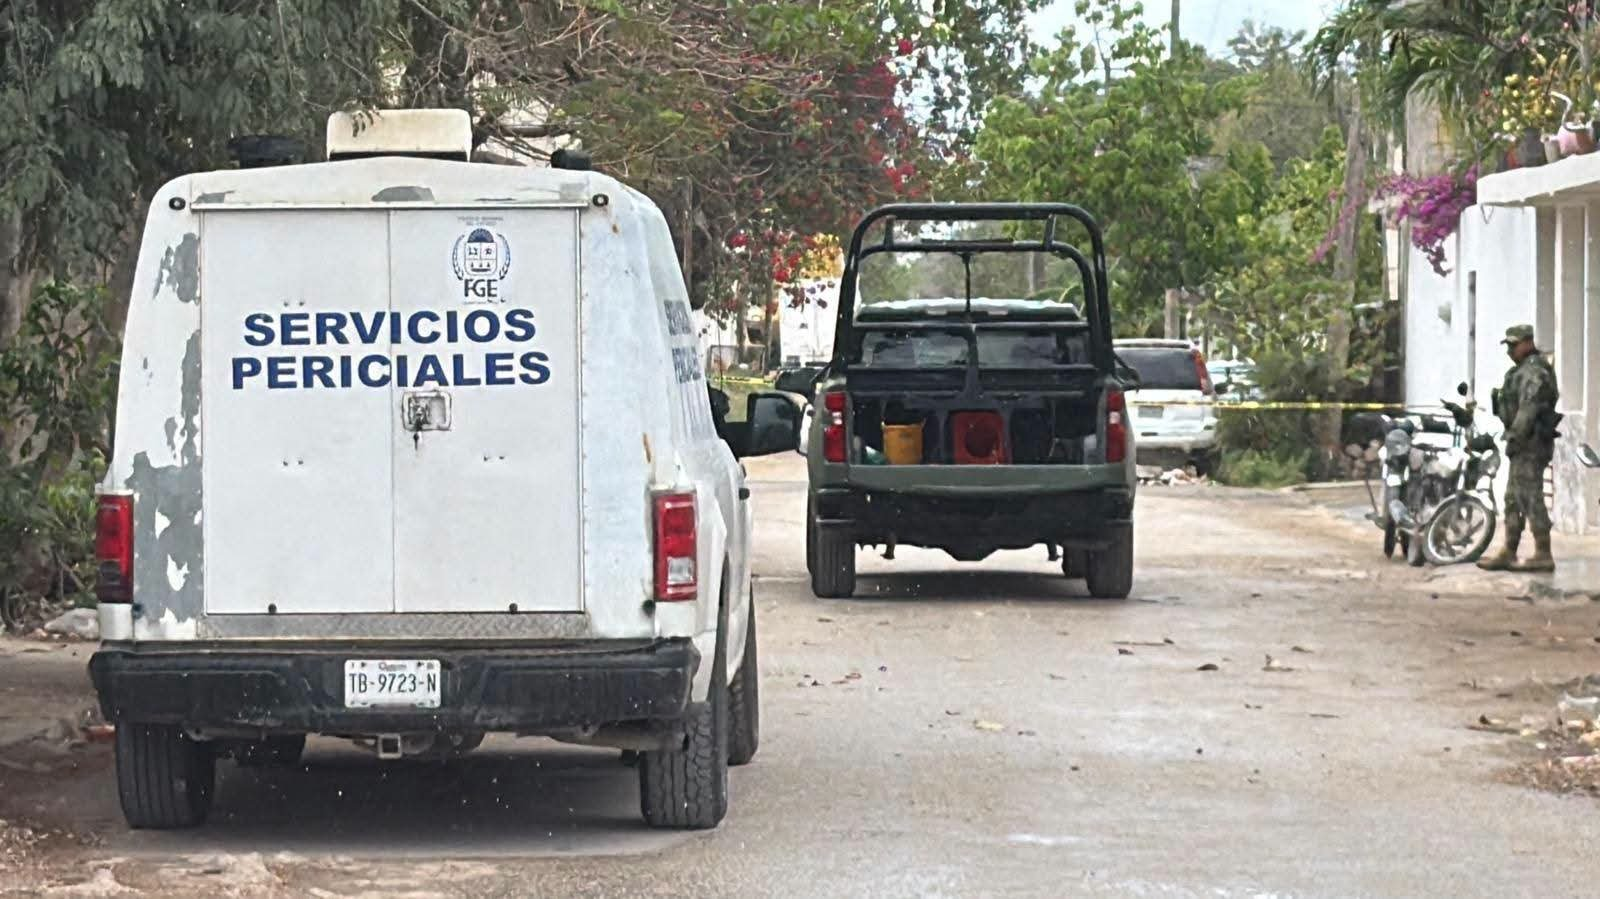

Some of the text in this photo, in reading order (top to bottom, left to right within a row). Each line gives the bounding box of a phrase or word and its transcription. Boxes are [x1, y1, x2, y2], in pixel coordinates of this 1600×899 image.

[464, 279, 498, 297] FGE
[244, 309, 536, 346] SERVICIOS
[232, 352, 551, 389] PERICIALES
[349, 673, 437, 693] TB-9723-N
